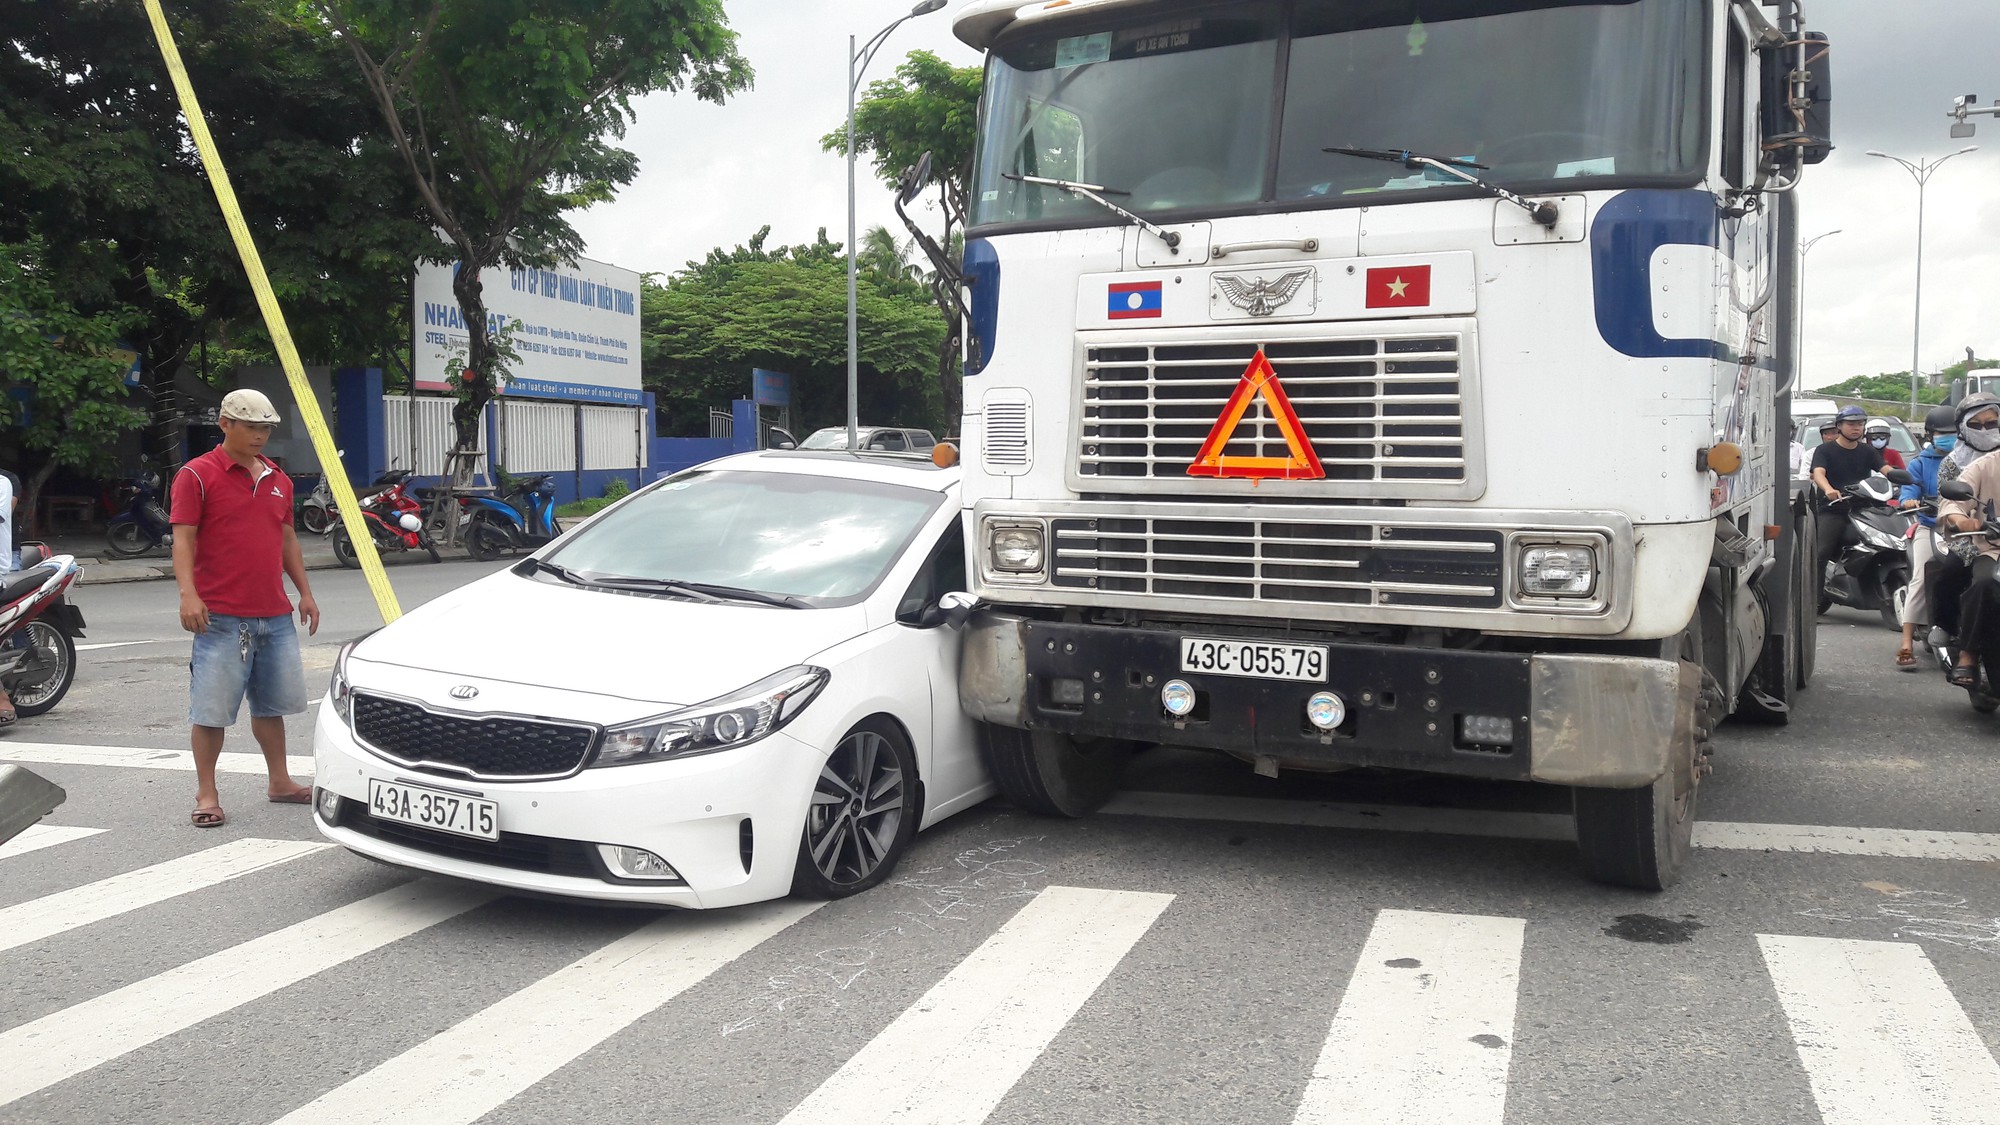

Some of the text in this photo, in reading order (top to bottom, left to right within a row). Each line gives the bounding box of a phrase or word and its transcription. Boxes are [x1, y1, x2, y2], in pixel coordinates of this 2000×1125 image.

[511, 267, 526, 292] CTY
[528, 267, 538, 295] CP
[614, 288, 634, 316] TRUNG
[425, 331, 447, 345] STEEL
[528, 381, 542, 392] luat
[542, 383, 558, 393] steel
[568, 385, 591, 396] member
[591, 386, 598, 396] of
[623, 391, 639, 402] group
[1186, 642, 1322, 679] 43C-055.79
[374, 784, 493, 834] 43A-357.15
